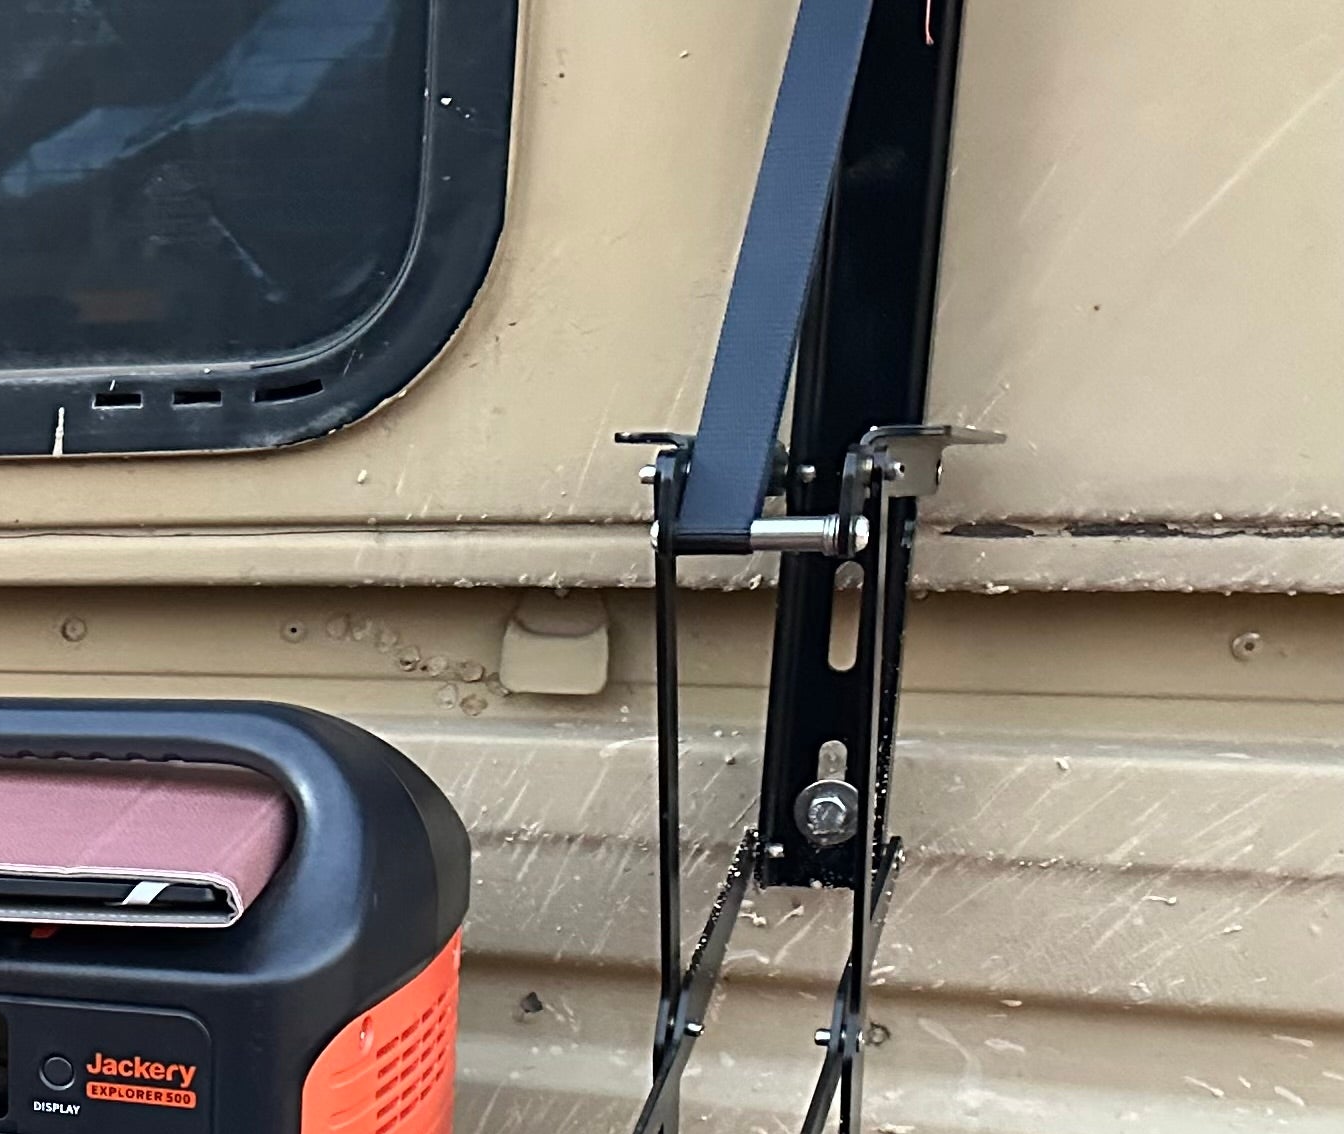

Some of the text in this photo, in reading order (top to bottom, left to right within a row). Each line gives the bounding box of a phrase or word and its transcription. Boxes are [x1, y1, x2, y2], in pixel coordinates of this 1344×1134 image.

[86, 1053, 196, 1088] Jackery
[91, 1085, 191, 1104] EXPLORER 500
[33, 1101, 80, 1115] DISPLAY
